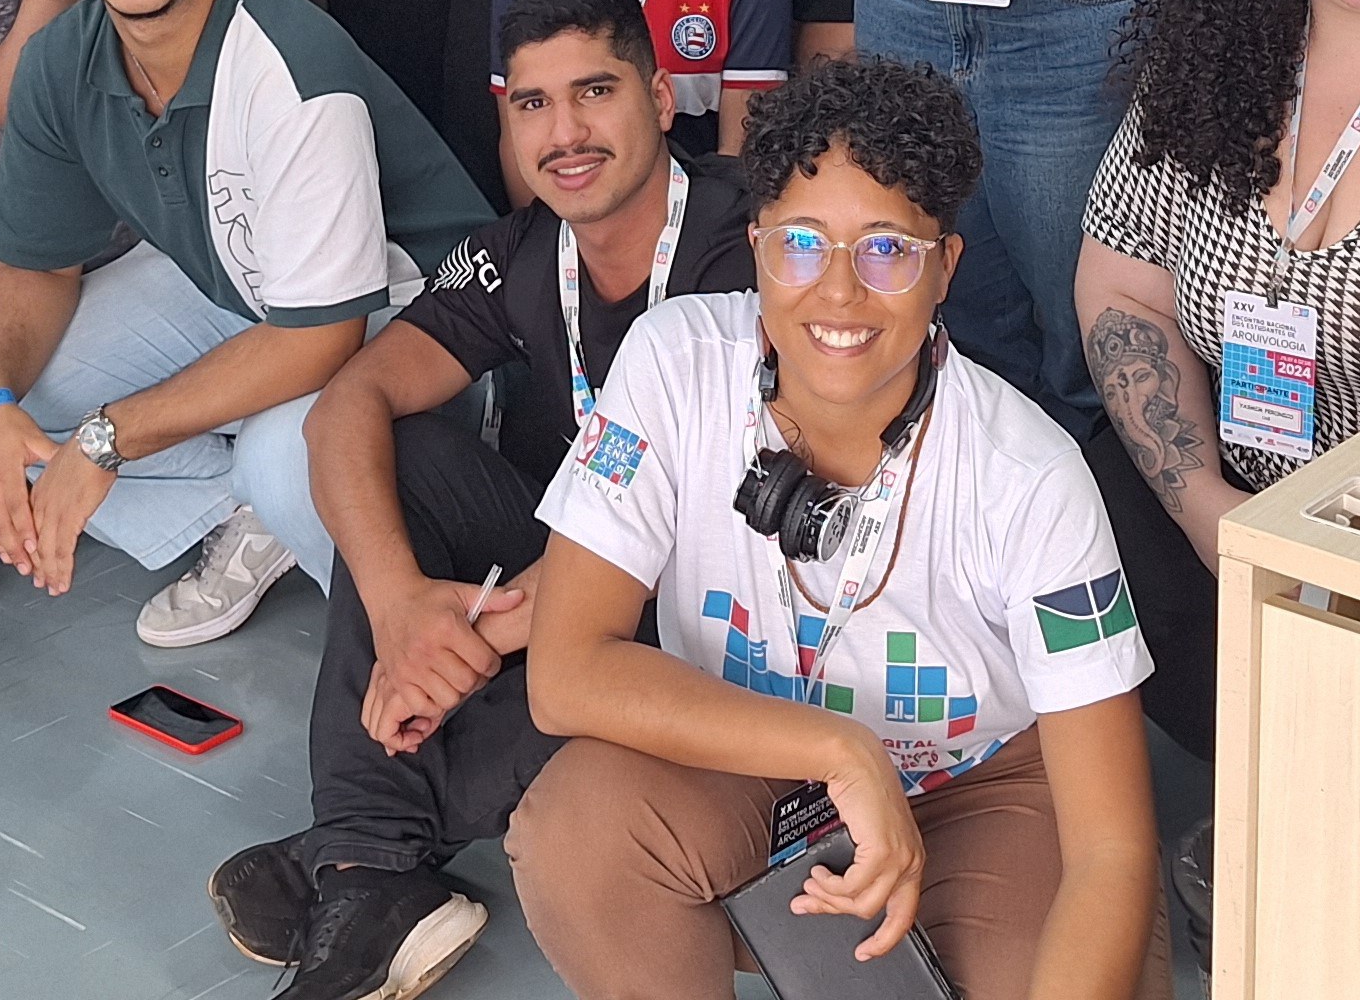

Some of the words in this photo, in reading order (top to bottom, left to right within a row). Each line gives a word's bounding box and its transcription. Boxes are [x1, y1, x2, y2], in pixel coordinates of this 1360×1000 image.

[472, 248, 502, 293] FCI
[1233, 301, 1255, 313] XXV
[1231, 329, 1307, 353] ARQUIVOLOGIA
[1277, 361, 1312, 380] 2024
[604, 444, 630, 464] ENE
[608, 434, 635, 454] XXV
[881, 738, 938, 750] GITAL
[780, 797, 800, 818] XXV
[777, 807, 838, 848] ARQUIVOLOG
